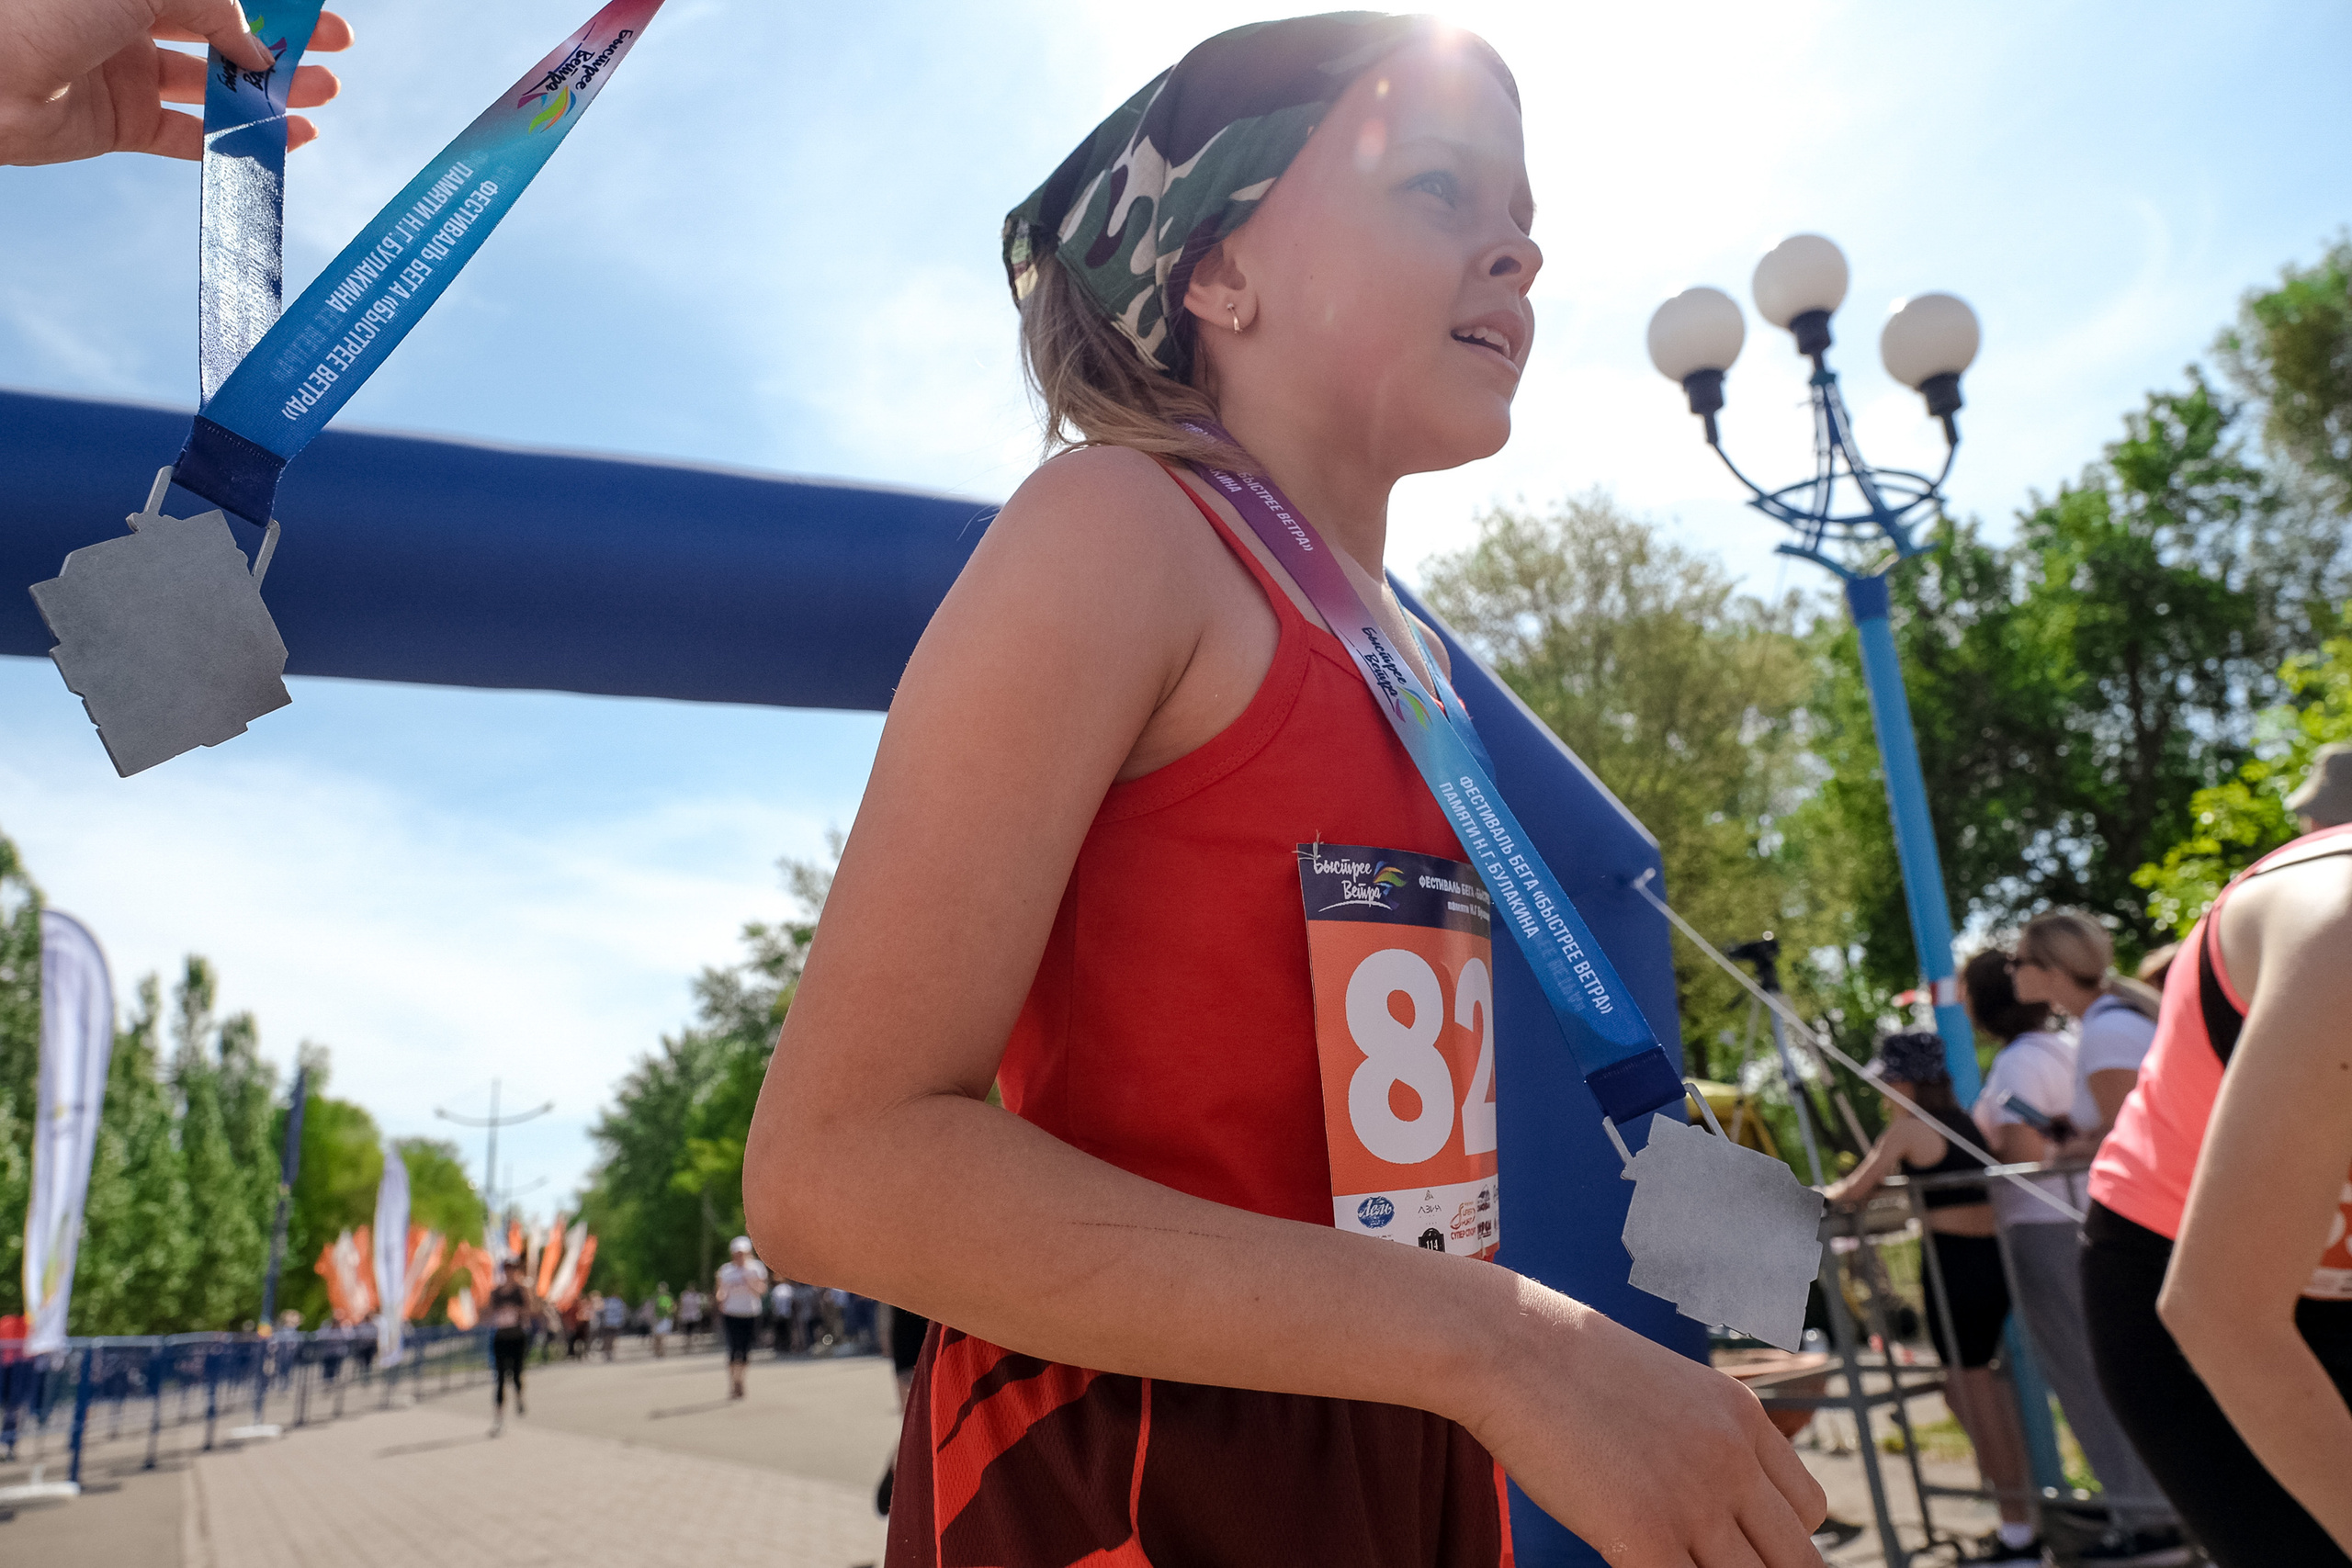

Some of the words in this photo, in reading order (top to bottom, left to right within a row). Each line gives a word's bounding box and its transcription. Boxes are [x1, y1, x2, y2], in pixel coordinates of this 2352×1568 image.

[546, 50, 596, 91] Ветра
[575, 29, 633, 90] Быстрее
[413, 161, 474, 220] ПАМЯТИ
[424, 180, 498, 261] ФЕСТИВАЛЬ
[392, 259, 433, 299] БЕГА
[326, 286, 400, 371] «БЫСТРЕЕ
[282, 363, 339, 421] ВЕТРА»
[1238, 470, 1283, 513] БЫСТРЕЕ
[1276, 512, 1314, 553] ВЕТРА»
[1362, 626, 1407, 685] Быстрее
[1364, 653, 1398, 698] Ветра
[1439, 782, 1480, 838] ПАМЯТИ
[1313, 855, 1372, 882] Быстрее
[1341, 880, 1382, 907] Ветра
[1419, 874, 1461, 894] ФЕСТИВАЛЬ
[1460, 776, 1516, 855] ФЕСТИВАЛЬ
[1508, 853, 1540, 891] БЕГА
[1532, 890, 1584, 964] «БЫСТРЕЕ
[1573, 960, 1614, 1015] ВЕТРА»
[1345, 948, 1498, 1165] 82
